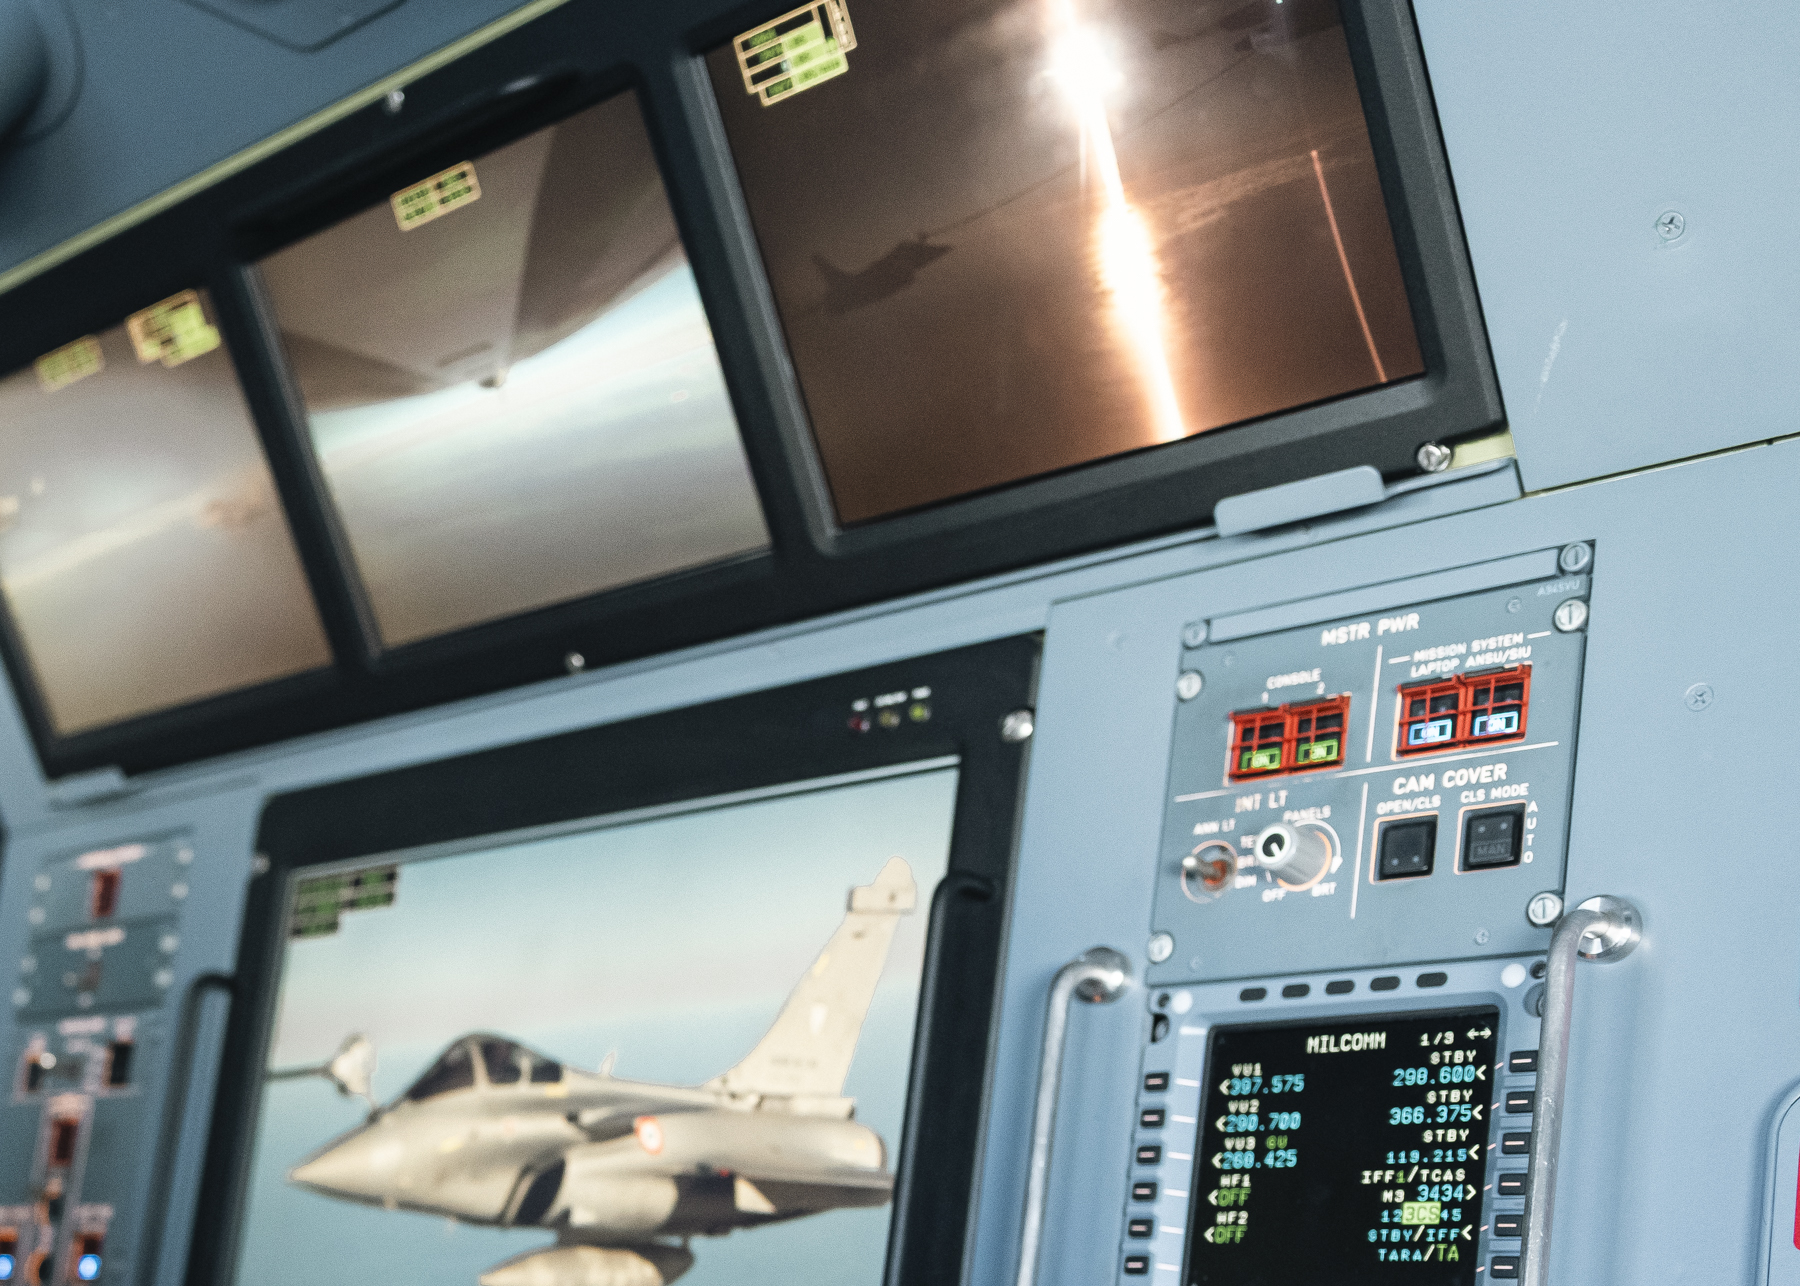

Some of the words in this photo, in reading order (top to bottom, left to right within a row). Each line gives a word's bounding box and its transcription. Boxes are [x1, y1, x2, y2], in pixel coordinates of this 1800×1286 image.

[1321, 622, 1371, 646] MSTR
[1377, 613, 1420, 636] PWR
[1413, 642, 1467, 662] MISSION
[1471, 632, 1524, 652] SYSTEM
[1410, 658, 1460, 678] LAPTOP
[1266, 667, 1322, 690] CONSOLE
[1393, 773, 1435, 795] CAM
[1442, 763, 1508, 788] COVER
[1268, 790, 1288, 808] LT
[1460, 789, 1486, 803] CLS
[1490, 783, 1530, 799] MODE
[1376, 795, 1441, 815] OPEN/CLS
[1306, 1031, 1386, 1054] MILCOMM
[1430, 1049, 1477, 1065] STBY
[1231, 1062, 1263, 1077] VU1
[1426, 1089, 1473, 1104] STBY
[1423, 1128, 1470, 1143] STBY
